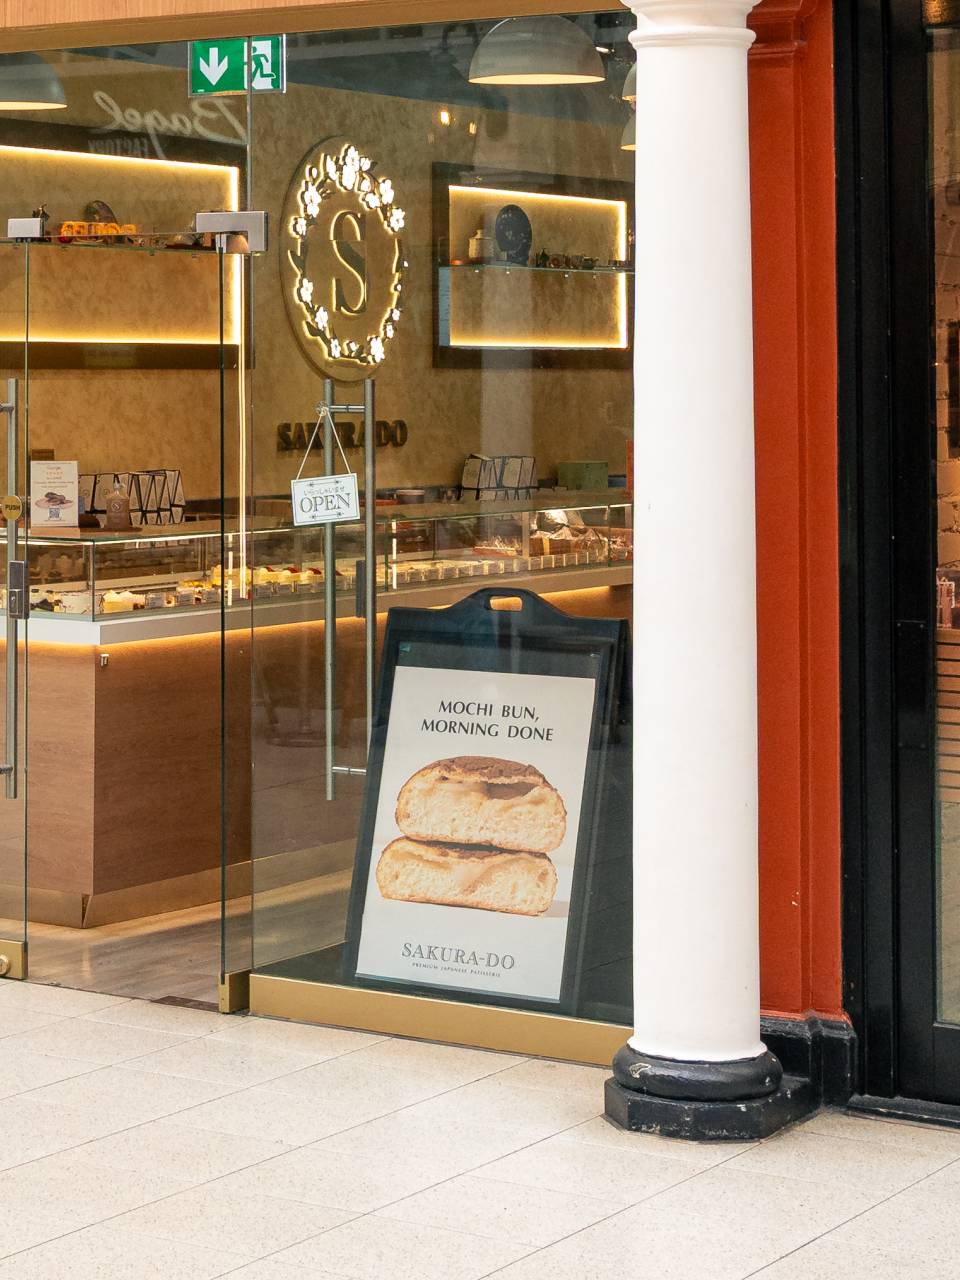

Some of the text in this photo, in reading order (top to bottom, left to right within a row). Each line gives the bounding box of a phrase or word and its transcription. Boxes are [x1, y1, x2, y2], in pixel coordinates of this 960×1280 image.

[330, 210, 368, 315] S
[300, 492, 352, 513] OPEN
[438, 700, 540, 722] MOCHI BUN,
[421, 718, 554, 742] MORNING DONE
[401, 942, 515, 970] SAKURA-DO
